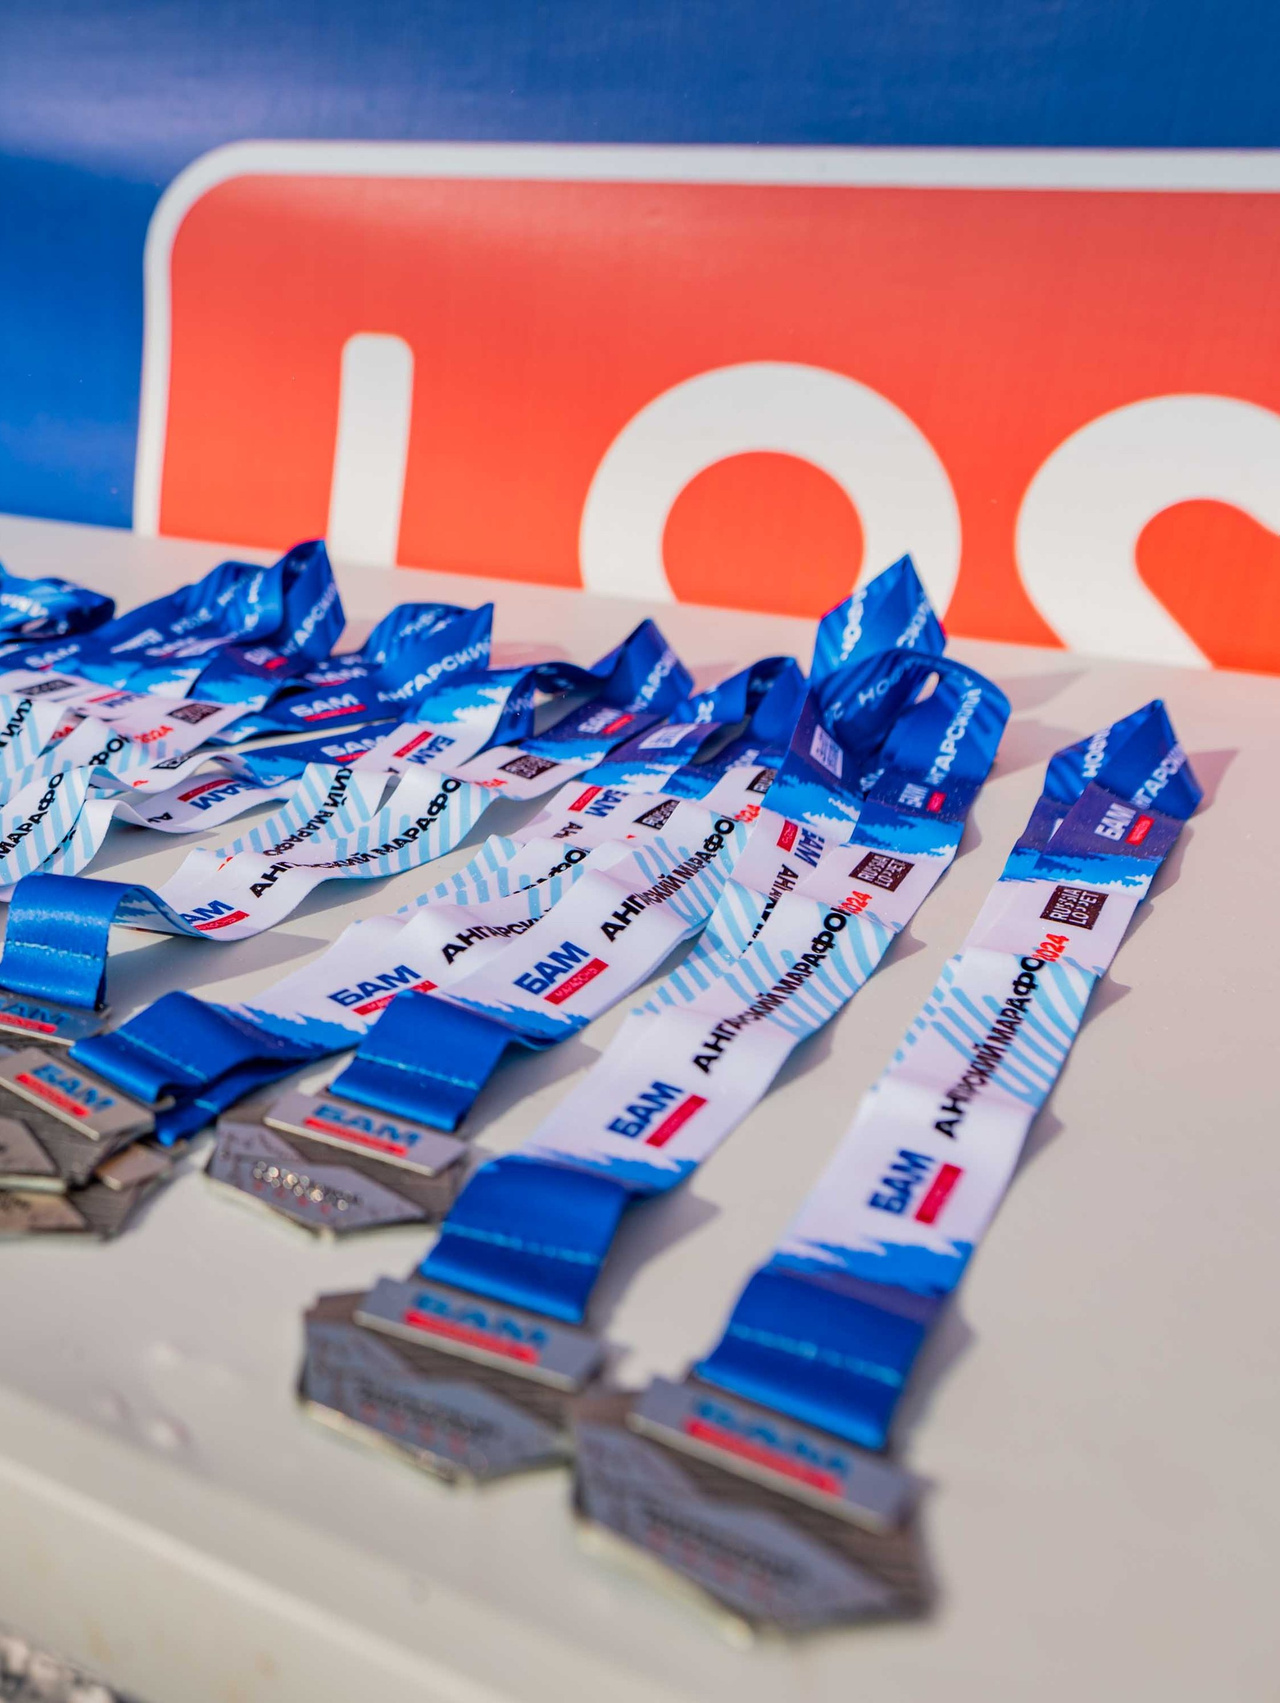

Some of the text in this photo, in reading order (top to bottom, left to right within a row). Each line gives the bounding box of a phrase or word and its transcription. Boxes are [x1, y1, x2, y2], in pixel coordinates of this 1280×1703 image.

[290, 694, 359, 719] БАМ
[376, 778, 465, 855] МАРАФО
[1094, 802, 1136, 841] БАМ
[677, 814, 737, 886] МАРАФО
[178, 900, 234, 925] АМ
[328, 964, 422, 1006] БАМ
[513, 940, 591, 995] БАМ
[989, 955, 1045, 1054] МАРАФО
[33, 1062, 116, 1112] БАМ
[608, 1081, 685, 1139] БАМ
[315, 1103, 419, 1149] БАМ
[867, 1148, 936, 1216] БАМ
